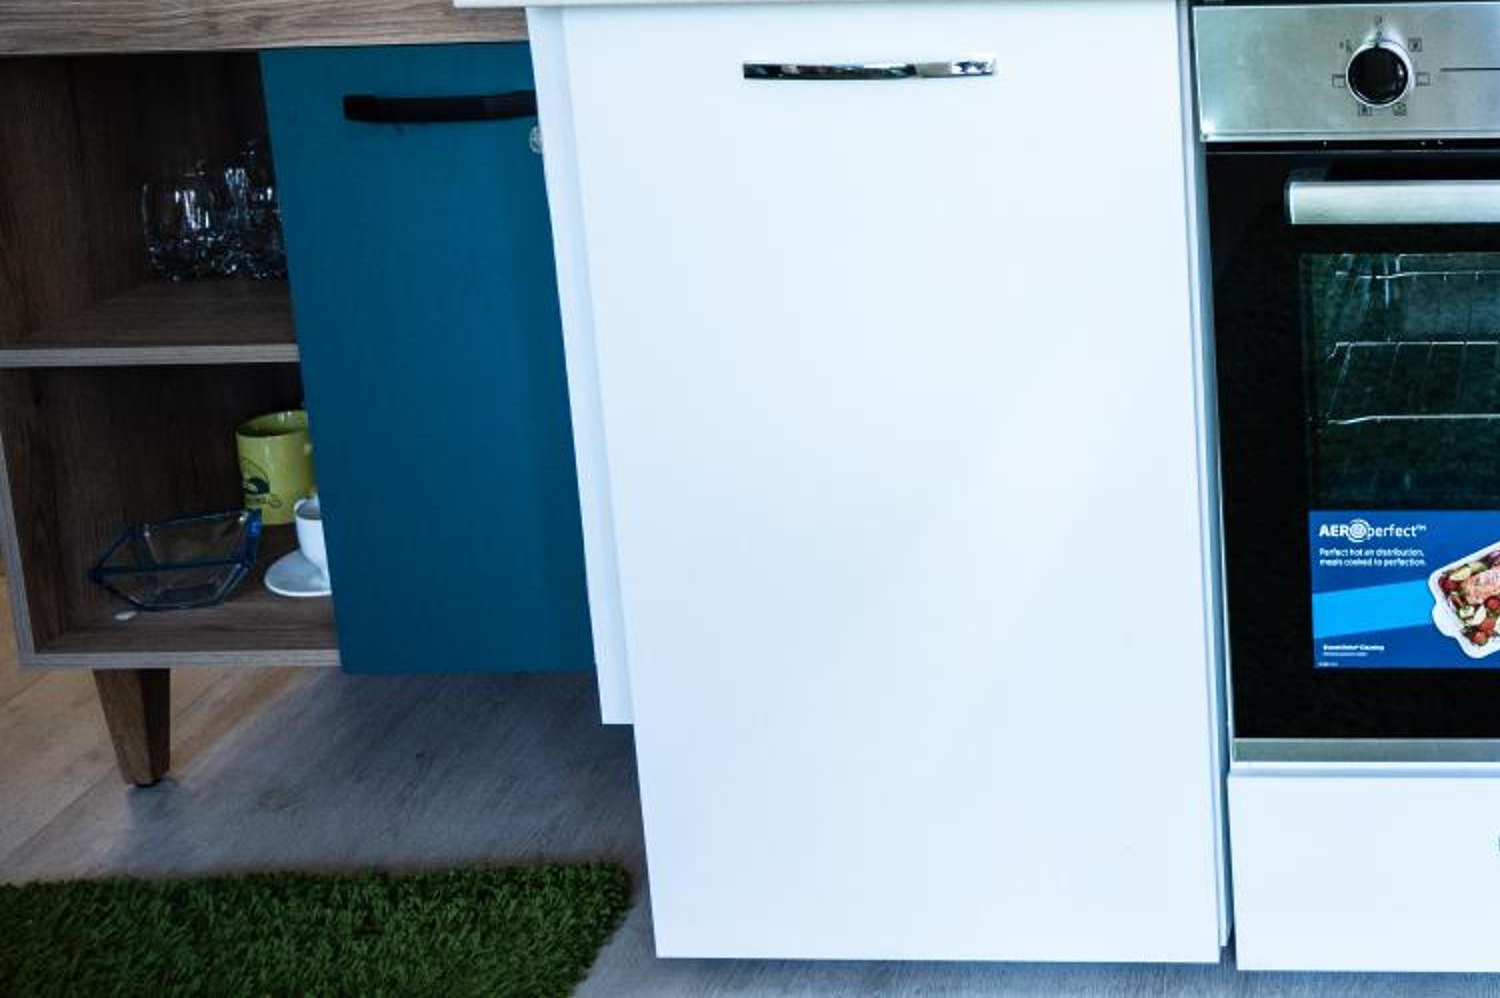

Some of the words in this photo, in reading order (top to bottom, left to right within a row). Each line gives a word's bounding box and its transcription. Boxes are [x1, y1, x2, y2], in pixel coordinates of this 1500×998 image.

[1319, 547, 1348, 557] Perfect
[1349, 548, 1363, 557] hot
[1373, 558, 1382, 567] to
